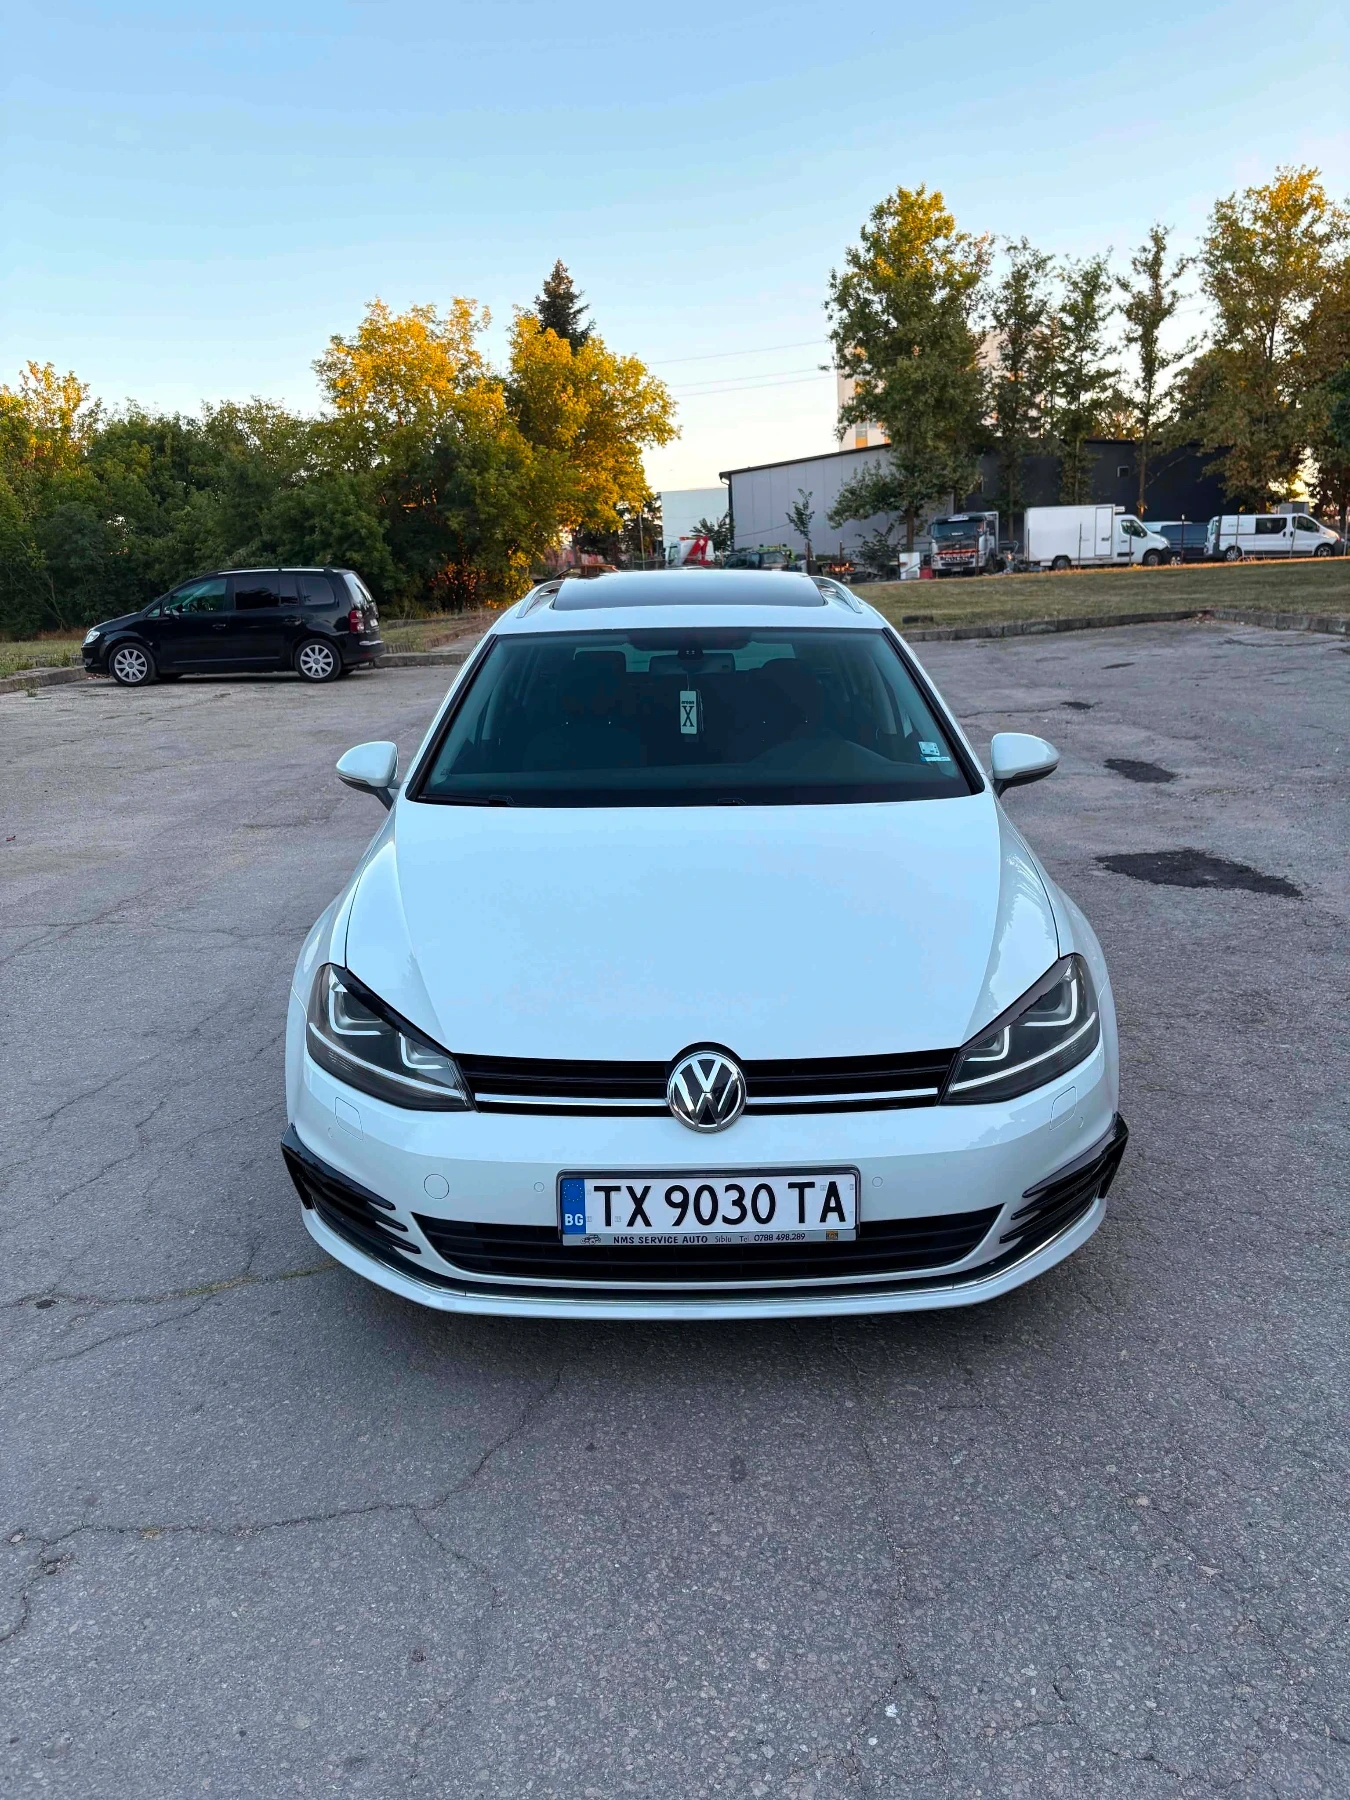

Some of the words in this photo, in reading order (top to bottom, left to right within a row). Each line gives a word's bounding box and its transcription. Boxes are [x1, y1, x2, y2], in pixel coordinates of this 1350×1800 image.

[681, 705, 695, 728] X
[593, 1185, 653, 1228] TX
[664, 1182, 777, 1227] 9030
[787, 1181, 847, 1224] TA
[564, 1213, 584, 1227] BG
[613, 1235, 635, 1245] NMS
[638, 1235, 679, 1244] SERVICE
[682, 1235, 708, 1244] AUTO
[753, 1234, 774, 1242] 0788
